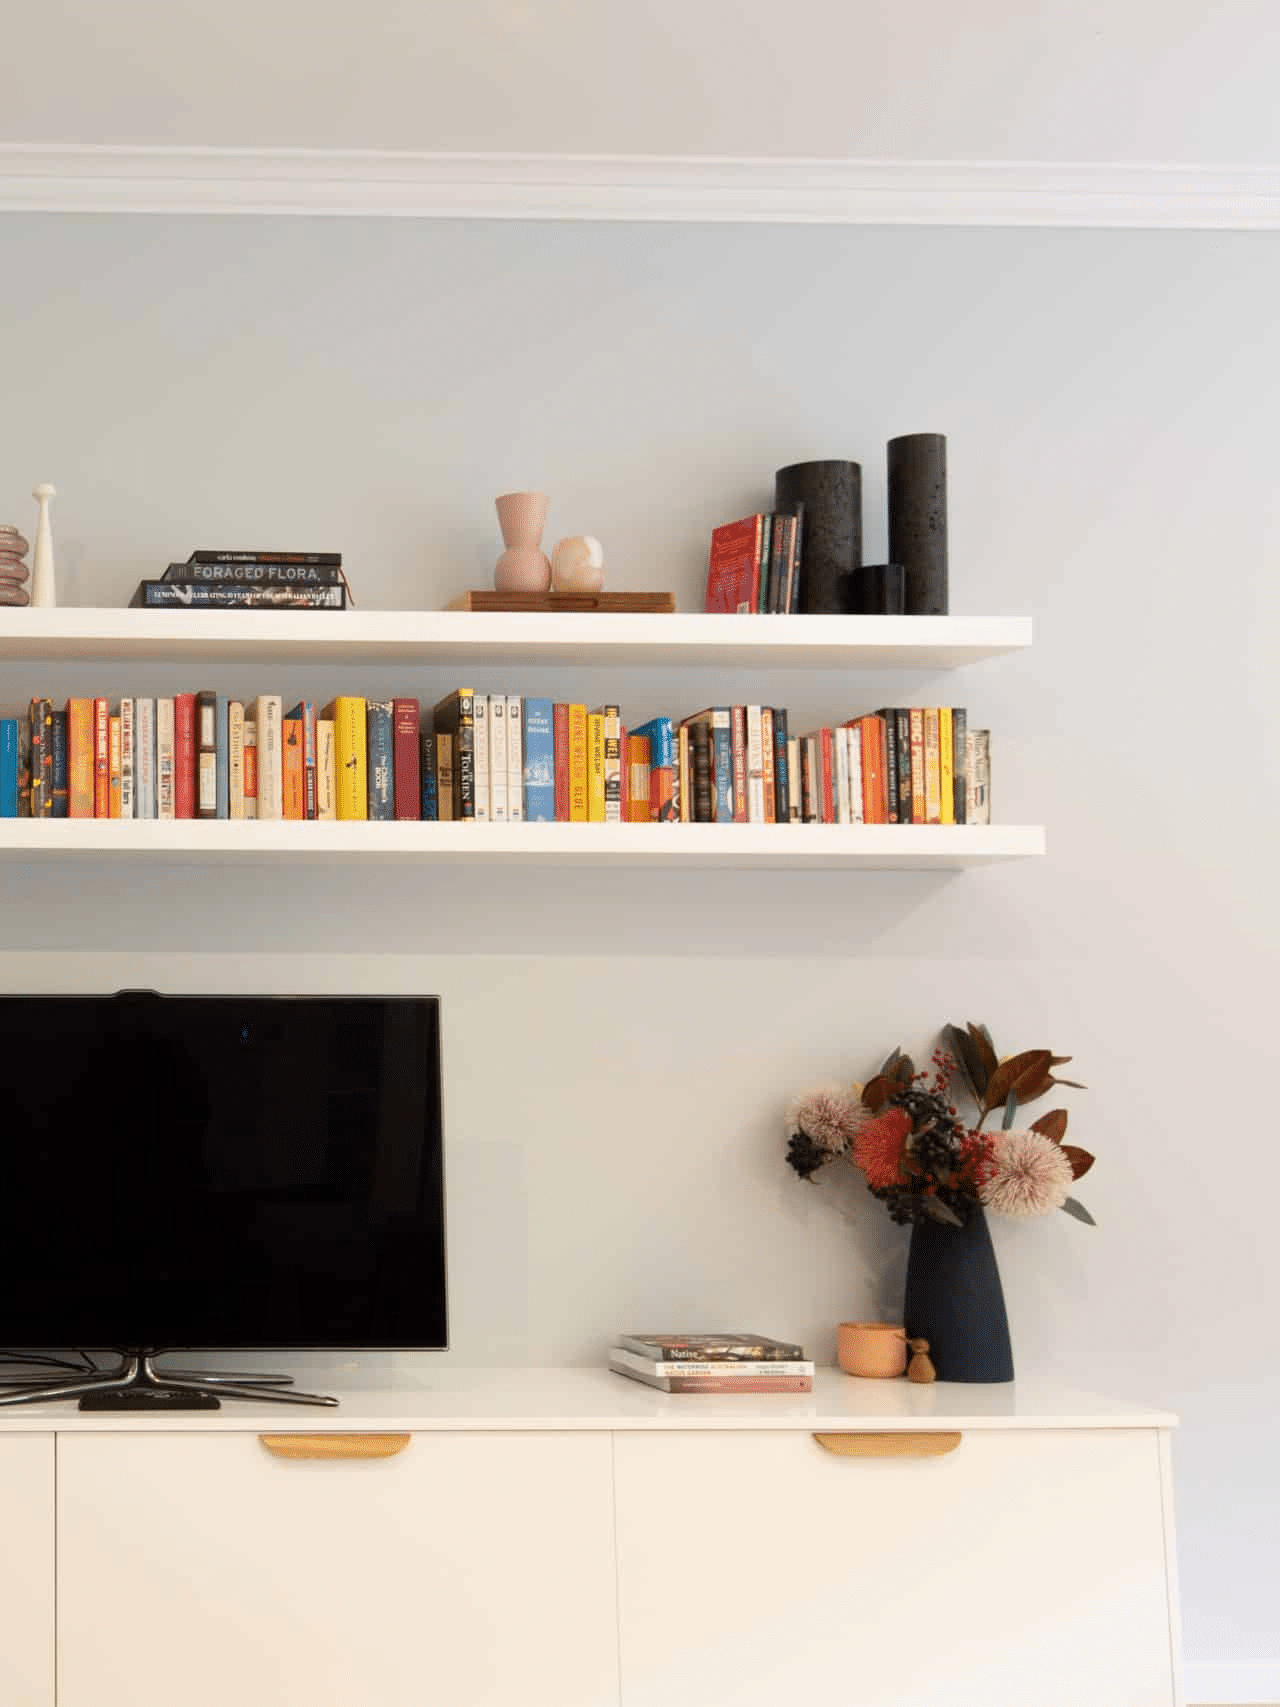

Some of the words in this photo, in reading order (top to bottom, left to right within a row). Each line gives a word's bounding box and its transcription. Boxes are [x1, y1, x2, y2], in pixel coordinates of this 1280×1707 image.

[193, 566, 264, 580] FORAGED
[122, 701, 132, 730] WILLIAM
[573, 708, 585, 742] IRVINE
[460, 754, 473, 801] TOLKIEN
[573, 746, 585, 780] WELSH
[573, 786, 585, 811] GLUE
